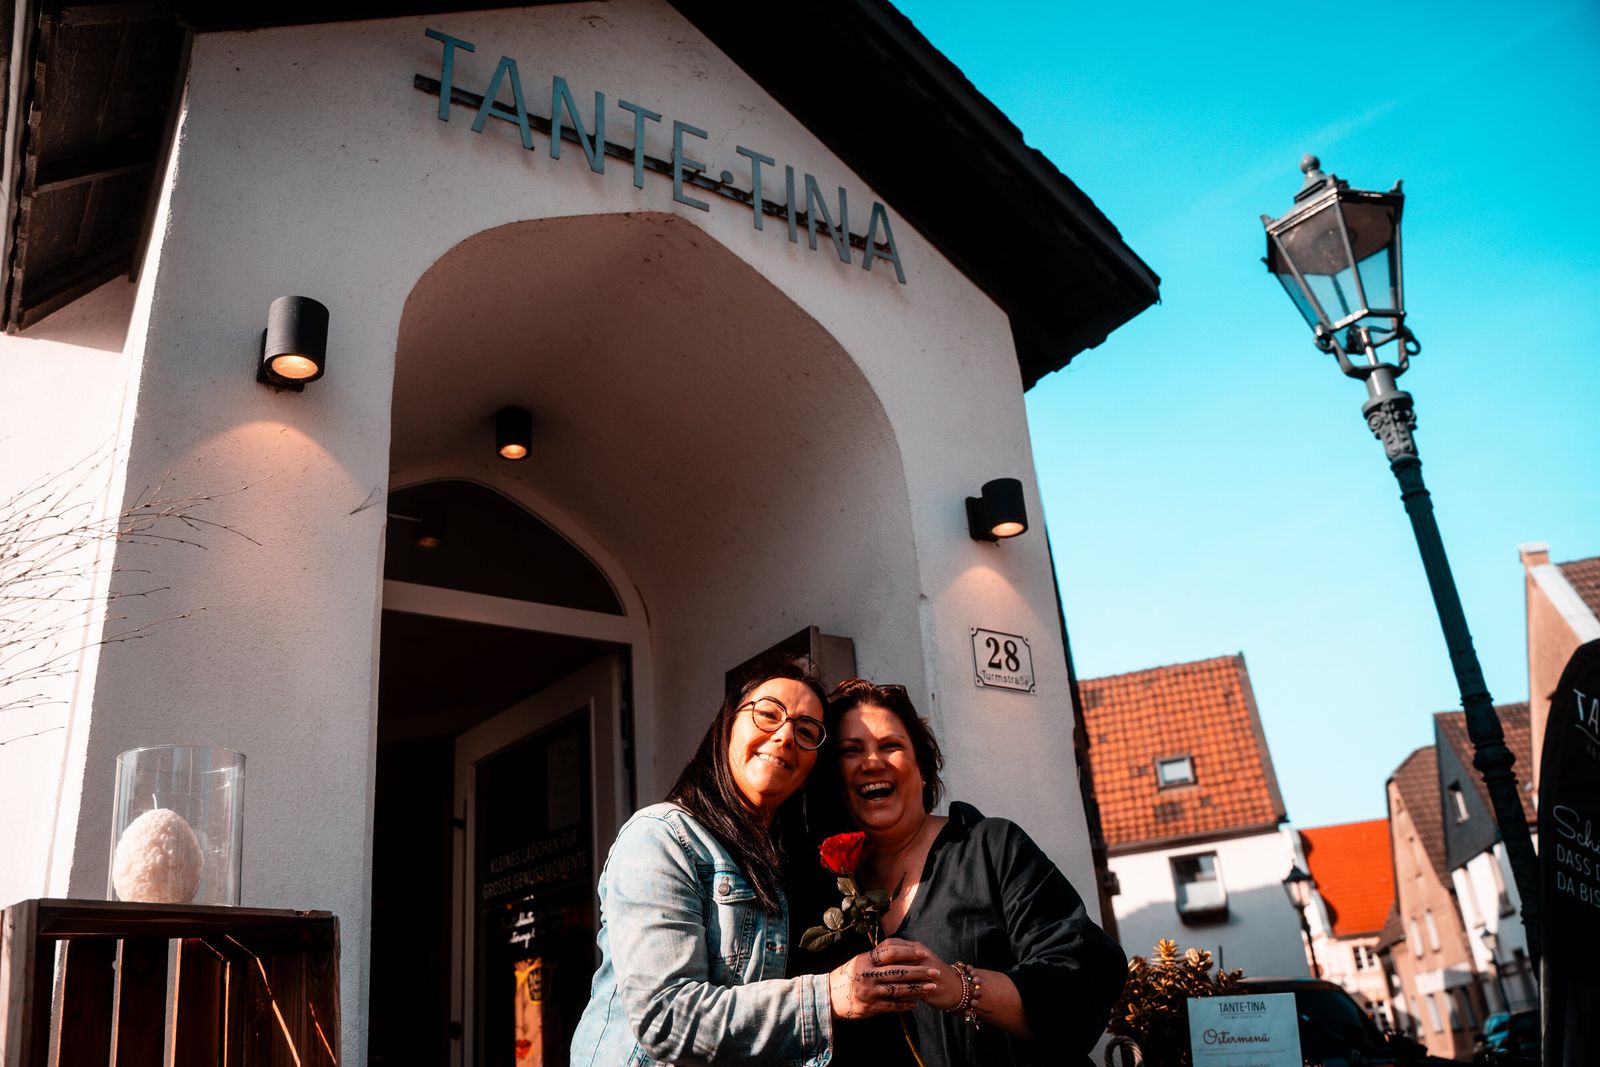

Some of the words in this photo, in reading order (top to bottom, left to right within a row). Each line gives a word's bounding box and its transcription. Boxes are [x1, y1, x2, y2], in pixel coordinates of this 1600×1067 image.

[985, 636, 1021, 672] 28
[981, 669, 1030, 687] Turmstraße
[1556, 843, 1591, 876] DASS
[1557, 871, 1575, 896] DA
[1202, 1028, 1271, 1045] Ostermenü
